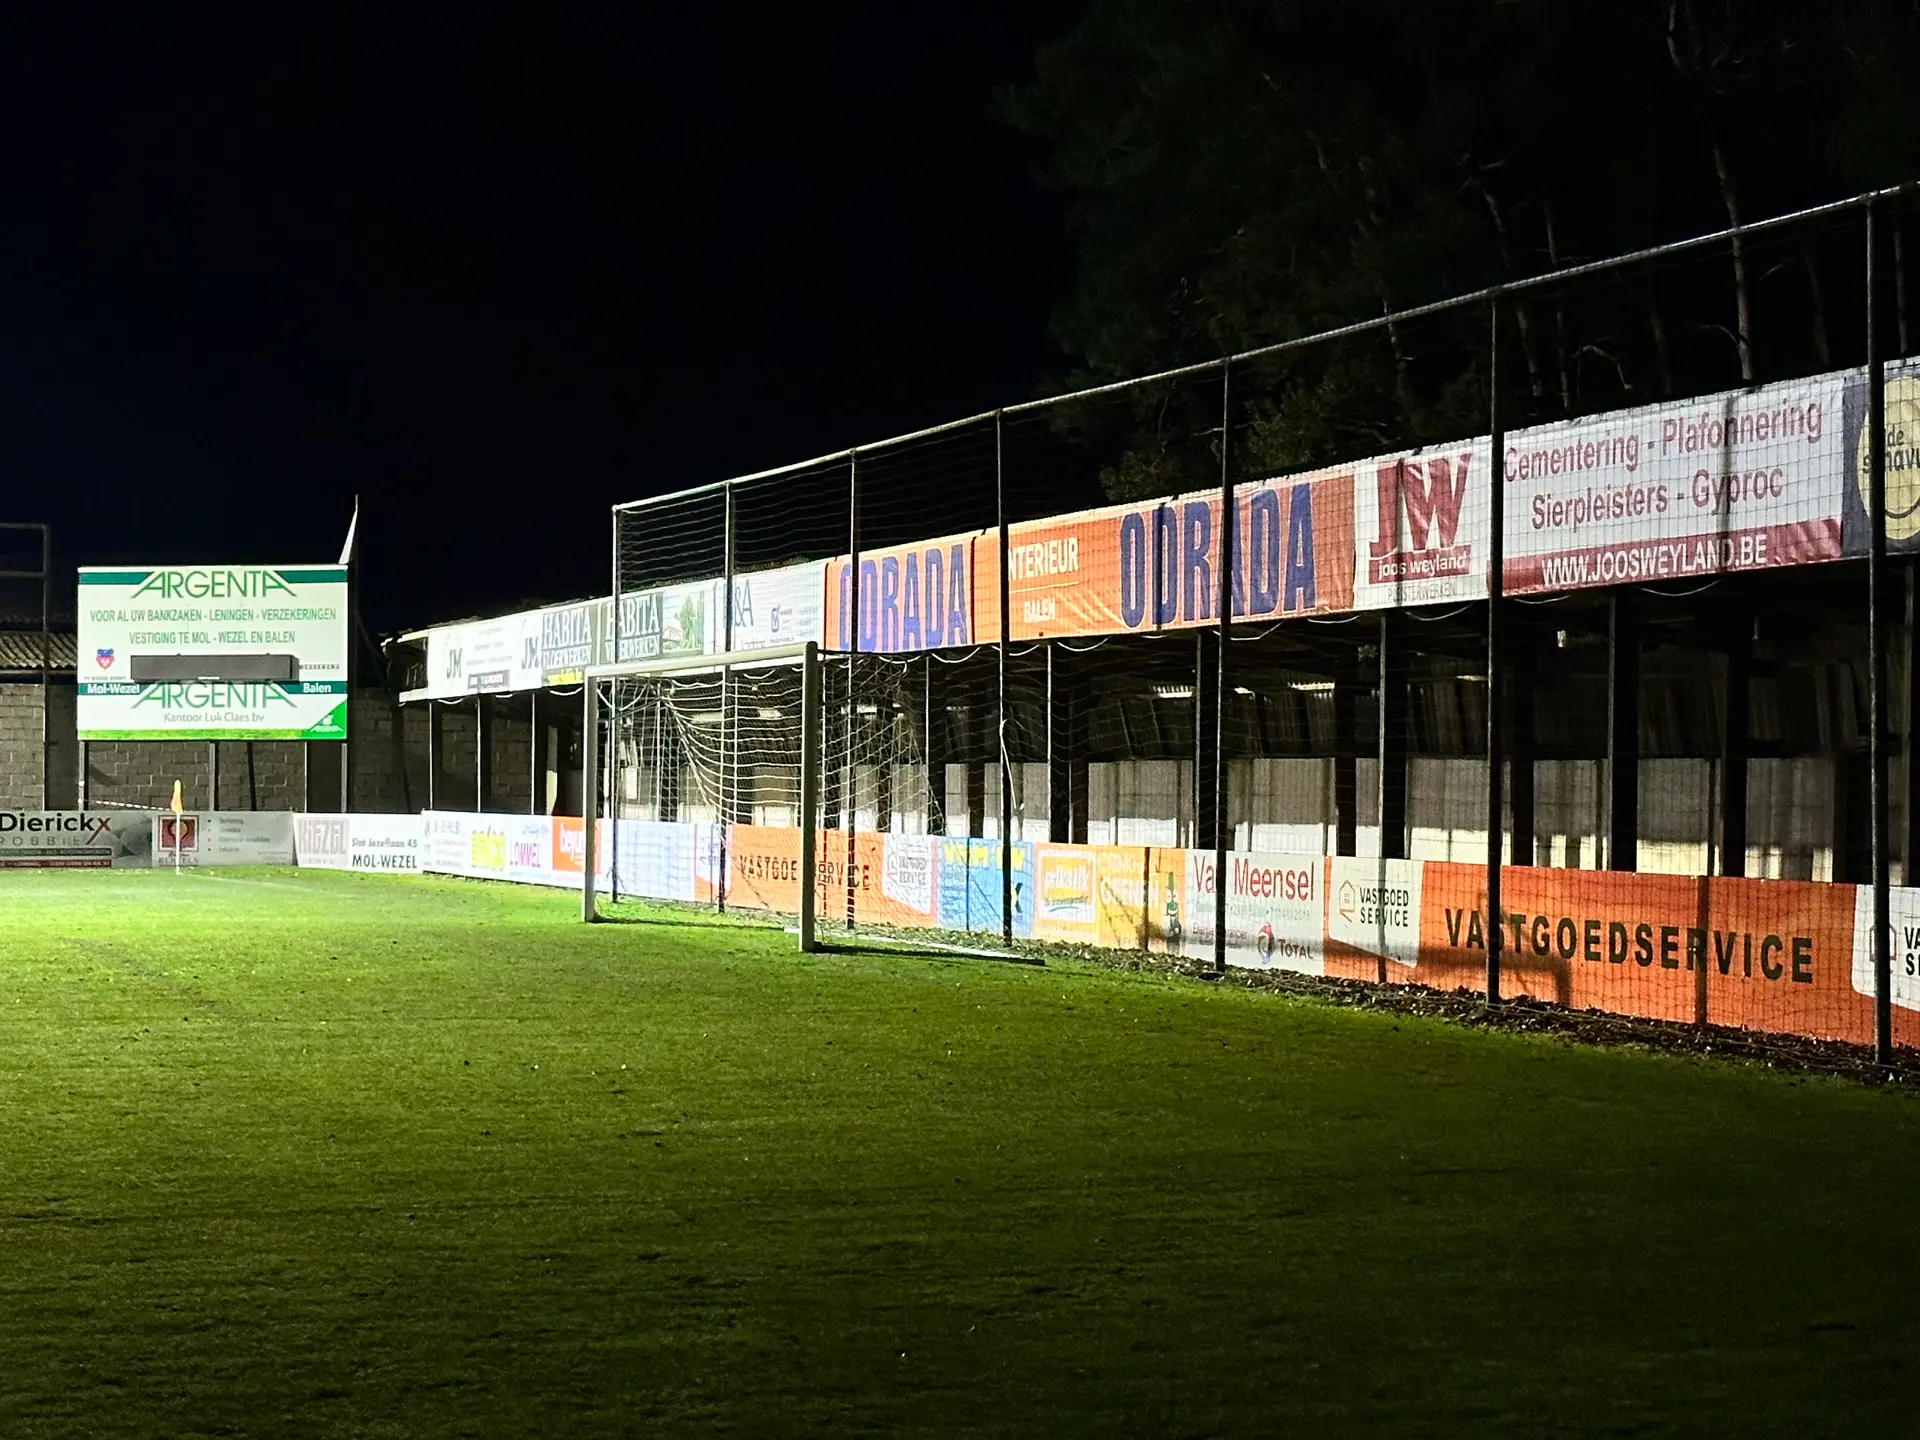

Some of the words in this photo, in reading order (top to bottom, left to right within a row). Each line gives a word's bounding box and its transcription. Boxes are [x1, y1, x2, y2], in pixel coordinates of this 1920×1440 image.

[1503, 429, 1639, 482] Cementering
[1661, 399, 1822, 456] Plafonnering
[1887, 424, 1904, 447] de
[1369, 453, 1472, 558] JW
[1532, 481, 1668, 534] Sierpleisters
[1692, 467, 1784, 516] Gyproc
[1008, 536, 1079, 583] NTERIEUR
[1378, 560, 1407, 581] joos
[1409, 552, 1468, 577] weyland
[1541, 534, 1768, 586] WWW.JOOSWEYLAND.BE
[131, 570, 297, 599] ARGENTA
[839, 543, 968, 652] ODRADA
[90, 610, 112, 622] VOOR
[112, 610, 129, 622] AL
[131, 609, 146, 622] UW
[147, 609, 201, 622] BANKZAKEN
[209, 609, 254, 621] LENINGEN
[261, 608, 337, 621] VERZEKERINGEN
[1024, 597, 1056, 623] BALEN
[129, 632, 177, 645] VESTIGING
[178, 632, 190, 644] TE
[191, 632, 211, 644] MOL
[218, 632, 249, 644] WEZEL
[251, 632, 263, 644] EN
[265, 631, 296, 643] BALEN
[542, 606, 593, 650] HABITA
[87, 683, 140, 695] Mol-Wezel
[130, 681, 298, 709] ARGENTA
[303, 682, 332, 693] Balen
[164, 712, 203, 722] Kantoor
[204, 711, 222, 722] Luk
[224, 711, 250, 722] Claes
[252, 712, 265, 722] bv
[0, 812, 111, 845] Dierickx
[352, 854, 418, 869] MOL-WEZEL
[1234, 858, 1315, 901] Meensel
[1359, 887, 1410, 908] VASTGOED
[1360, 909, 1409, 928] SERVICE
[1276, 938, 1314, 959] TOTAL
